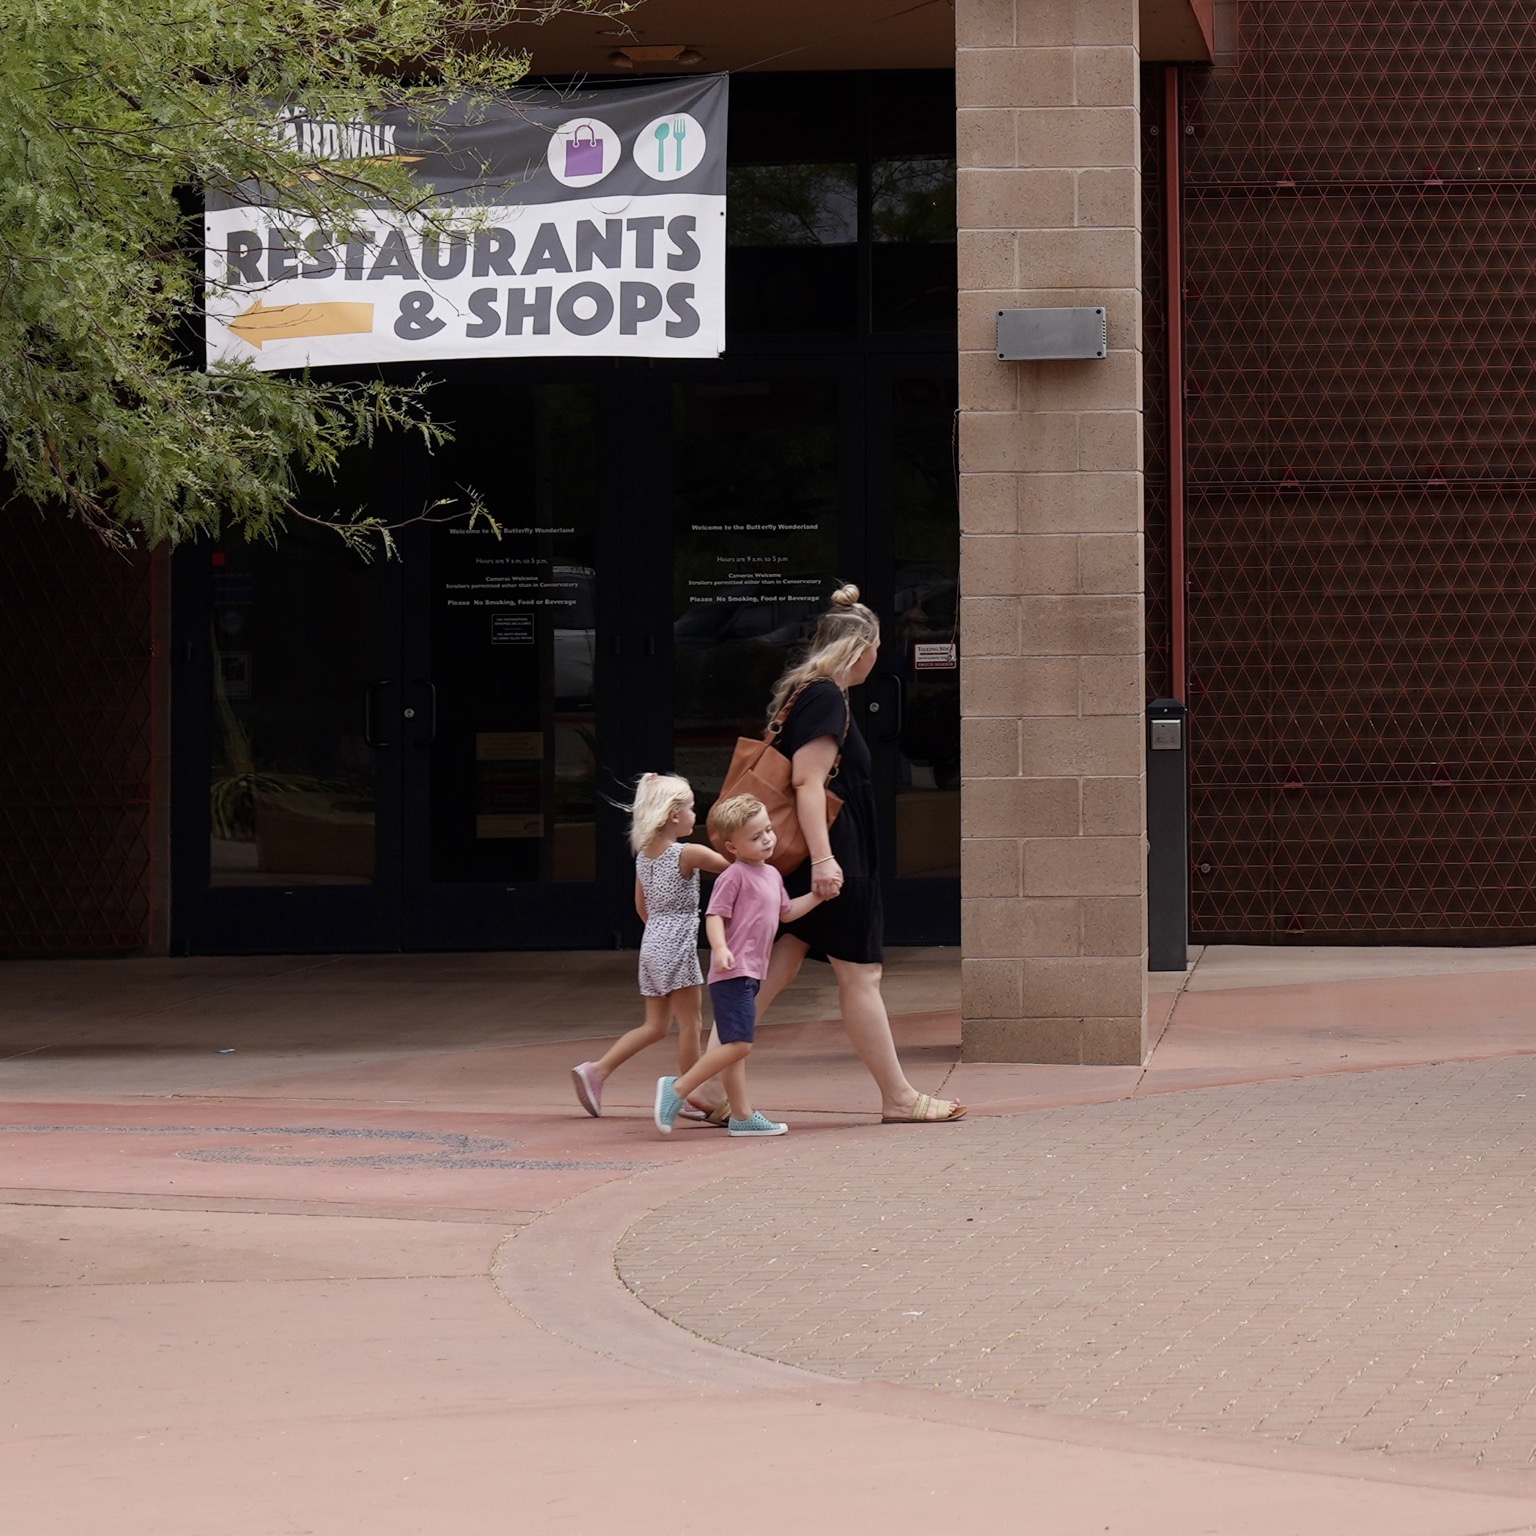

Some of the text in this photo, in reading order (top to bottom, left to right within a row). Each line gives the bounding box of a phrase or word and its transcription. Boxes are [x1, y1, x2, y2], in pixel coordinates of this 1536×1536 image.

[246, 121, 397, 162] ARDWALK
[226, 215, 700, 286] RESTAURANTS
[394, 281, 701, 341] & SHOPS
[504, 527, 533, 535] Butterfly
[746, 524, 777, 532] Butterfly
[545, 598, 577, 606] Beverage
[728, 595, 759, 603] Smoking,
